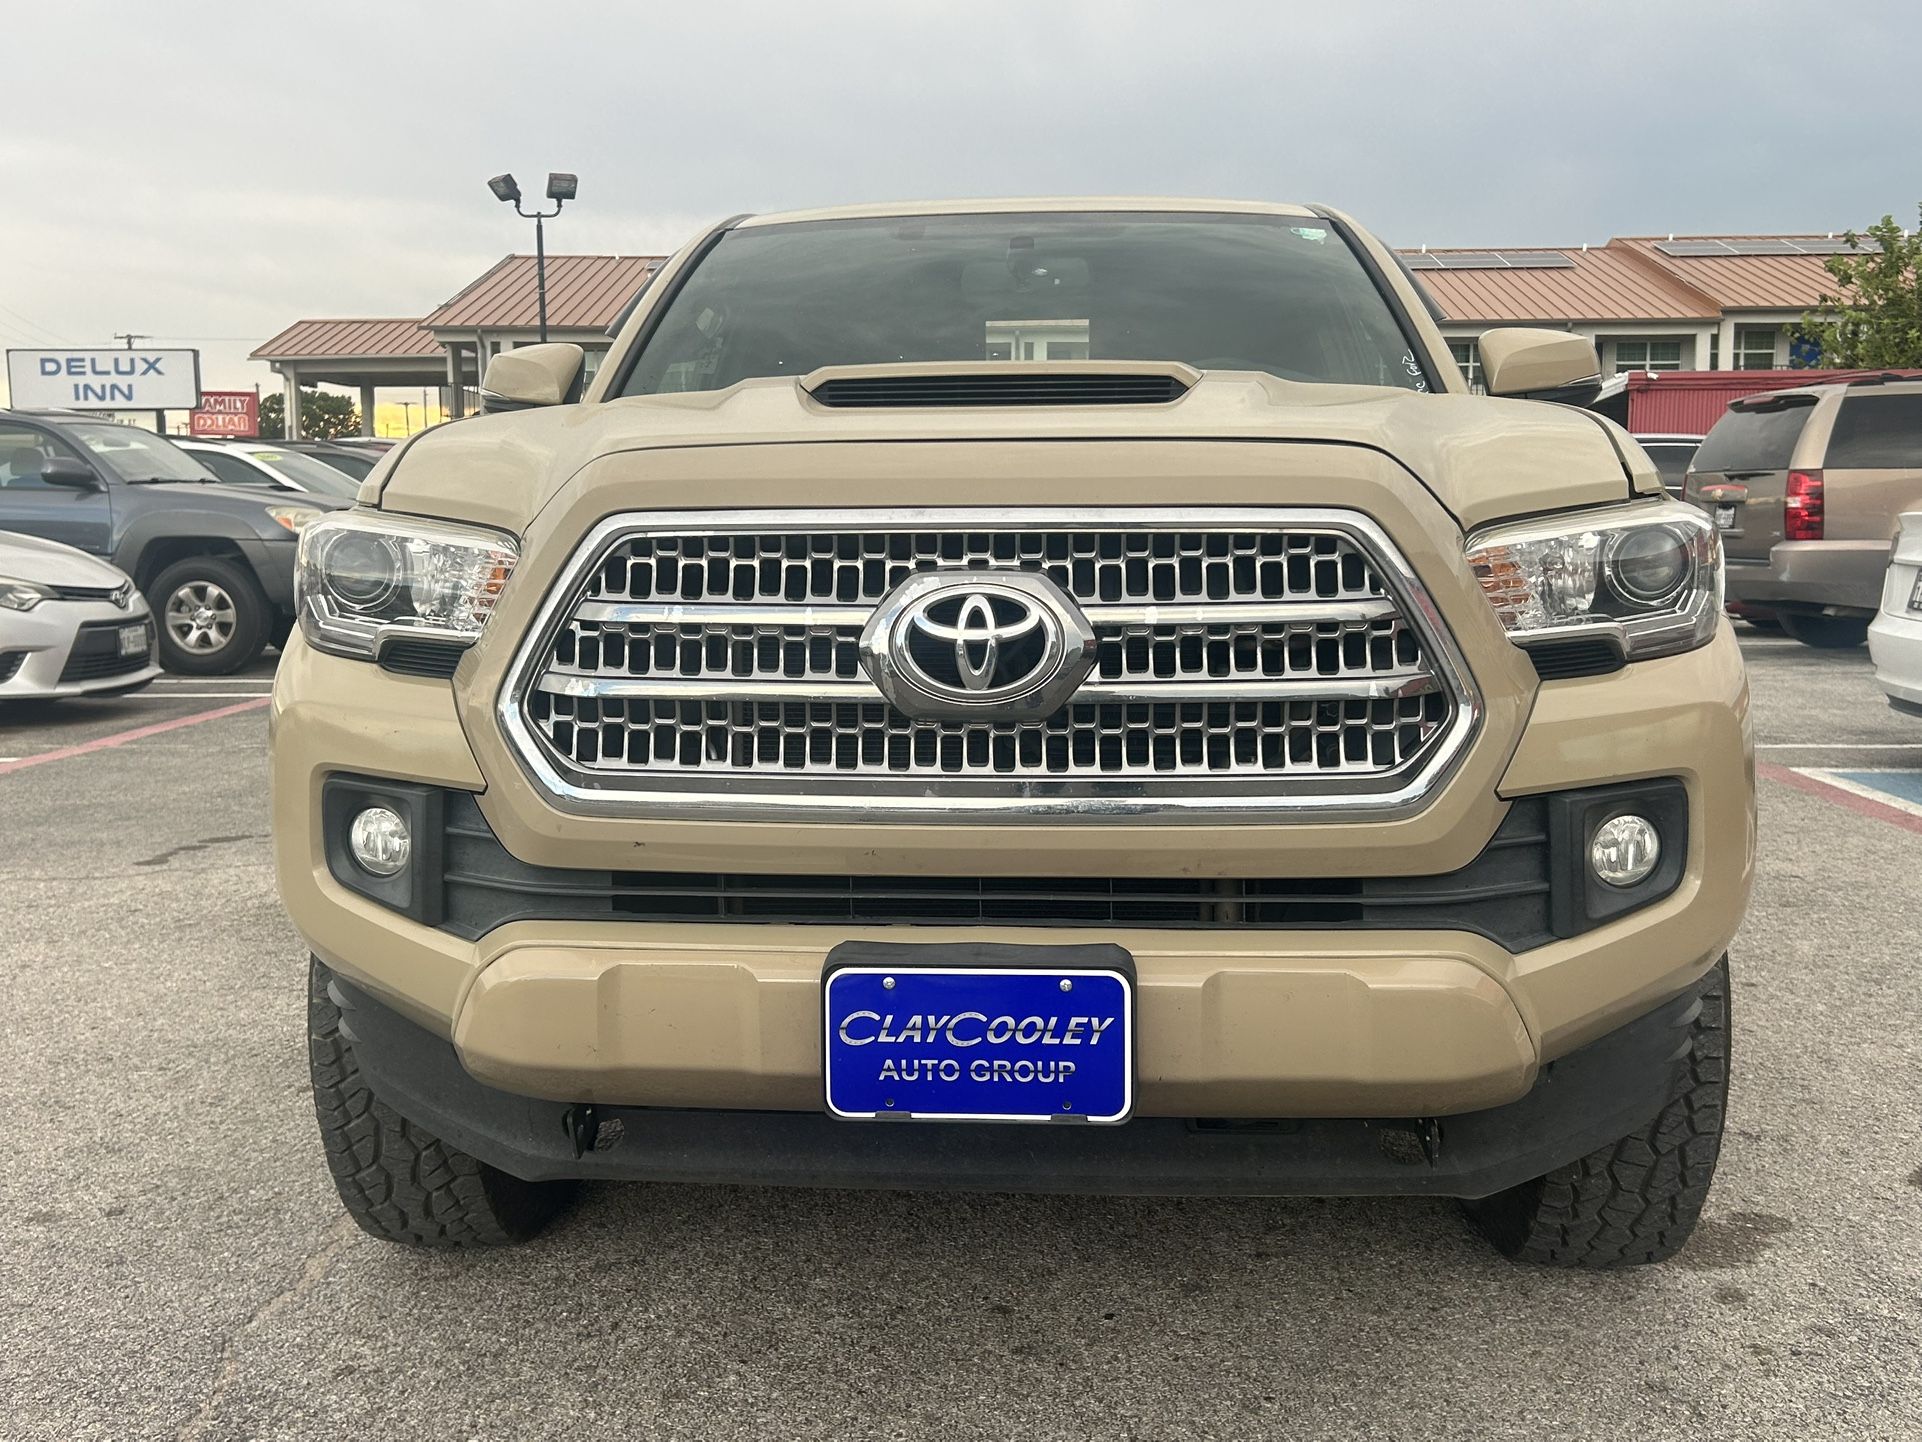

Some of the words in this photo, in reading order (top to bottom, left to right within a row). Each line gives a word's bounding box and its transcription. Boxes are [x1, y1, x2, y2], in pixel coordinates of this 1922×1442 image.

[39, 357, 165, 376] DELUX
[73, 383, 134, 402] INN
[200, 395, 250, 413] AMILY
[878, 1058, 960, 1082] AUTO
[970, 1060, 1076, 1083] GROUP
